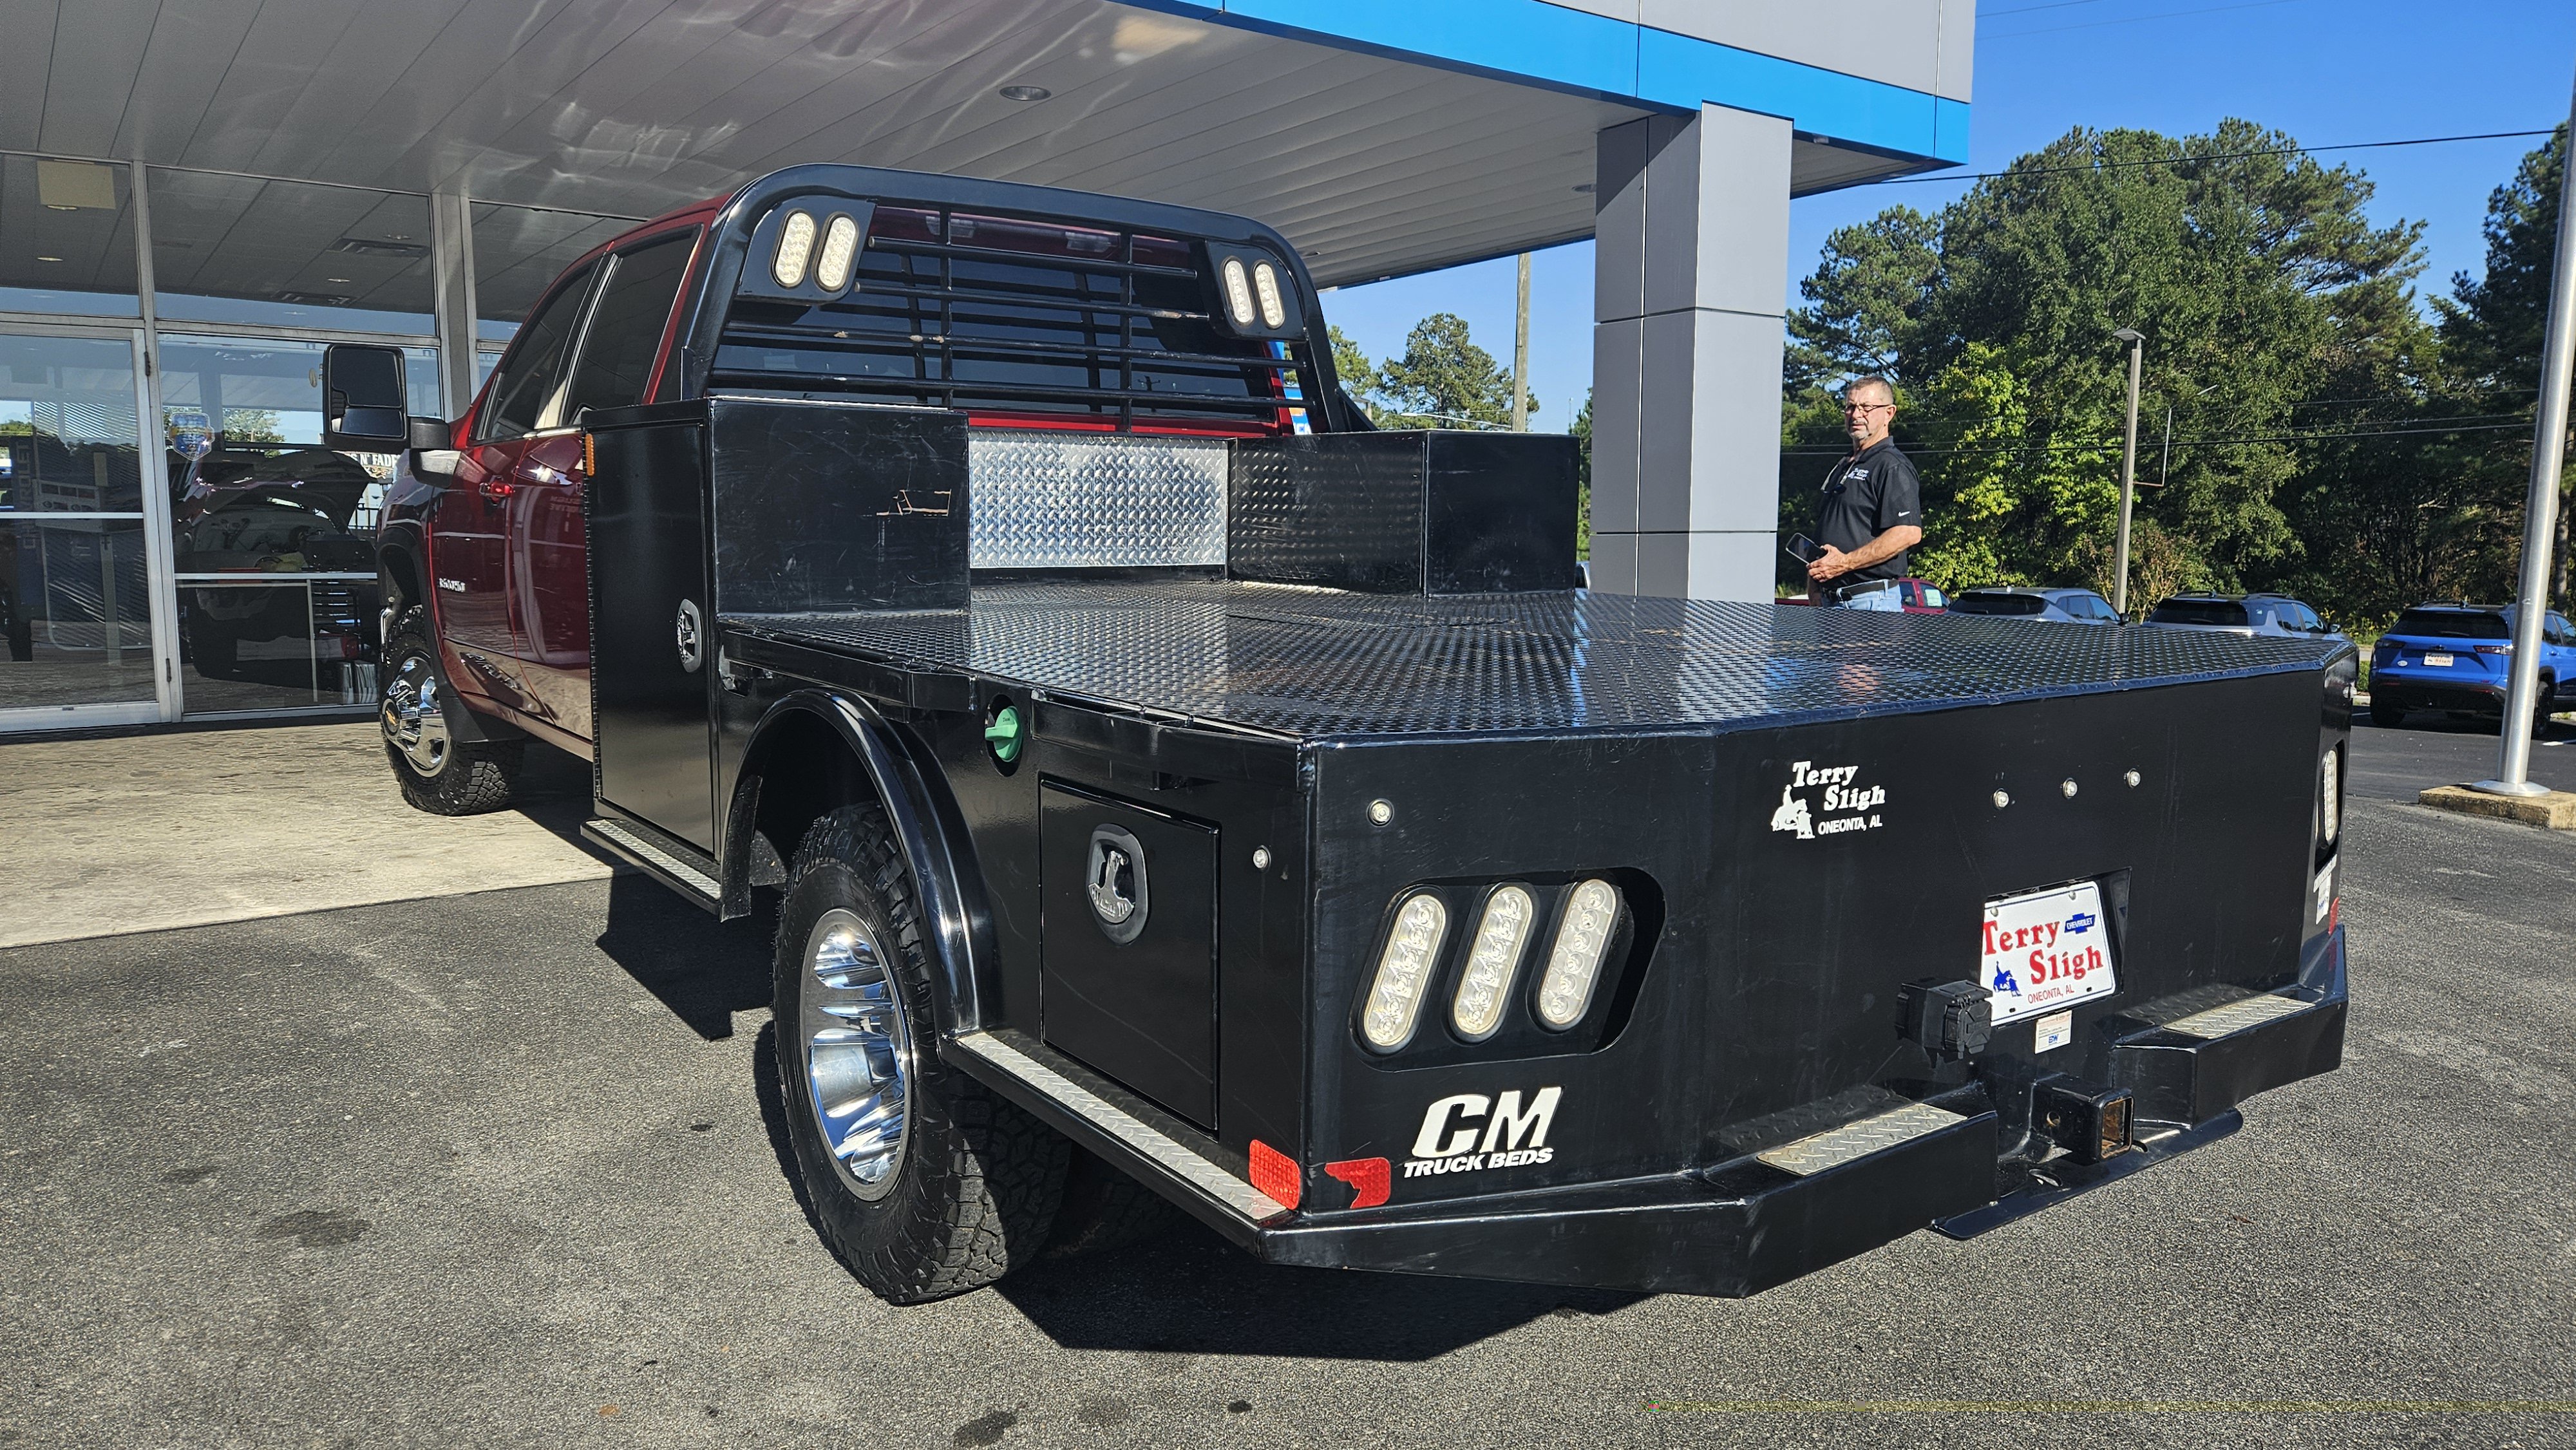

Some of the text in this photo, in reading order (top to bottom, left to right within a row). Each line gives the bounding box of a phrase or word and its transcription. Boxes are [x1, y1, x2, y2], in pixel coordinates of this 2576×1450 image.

[372, 453, 401, 467] FADE
[1792, 761, 1859, 787] Terry
[1824, 784, 1886, 811] Sligh
[1818, 814, 1883, 835] ONEONTA, AL
[2067, 917, 2093, 930] CHEVROLET
[1983, 920, 2060, 956] Terry
[2029, 946, 2103, 984] Sligh
[2028, 984, 2075, 1004] ONEONTA, AL
[1412, 1086, 1563, 1158] CM
[1404, 1147, 1554, 1178] TRUCK BEDS
